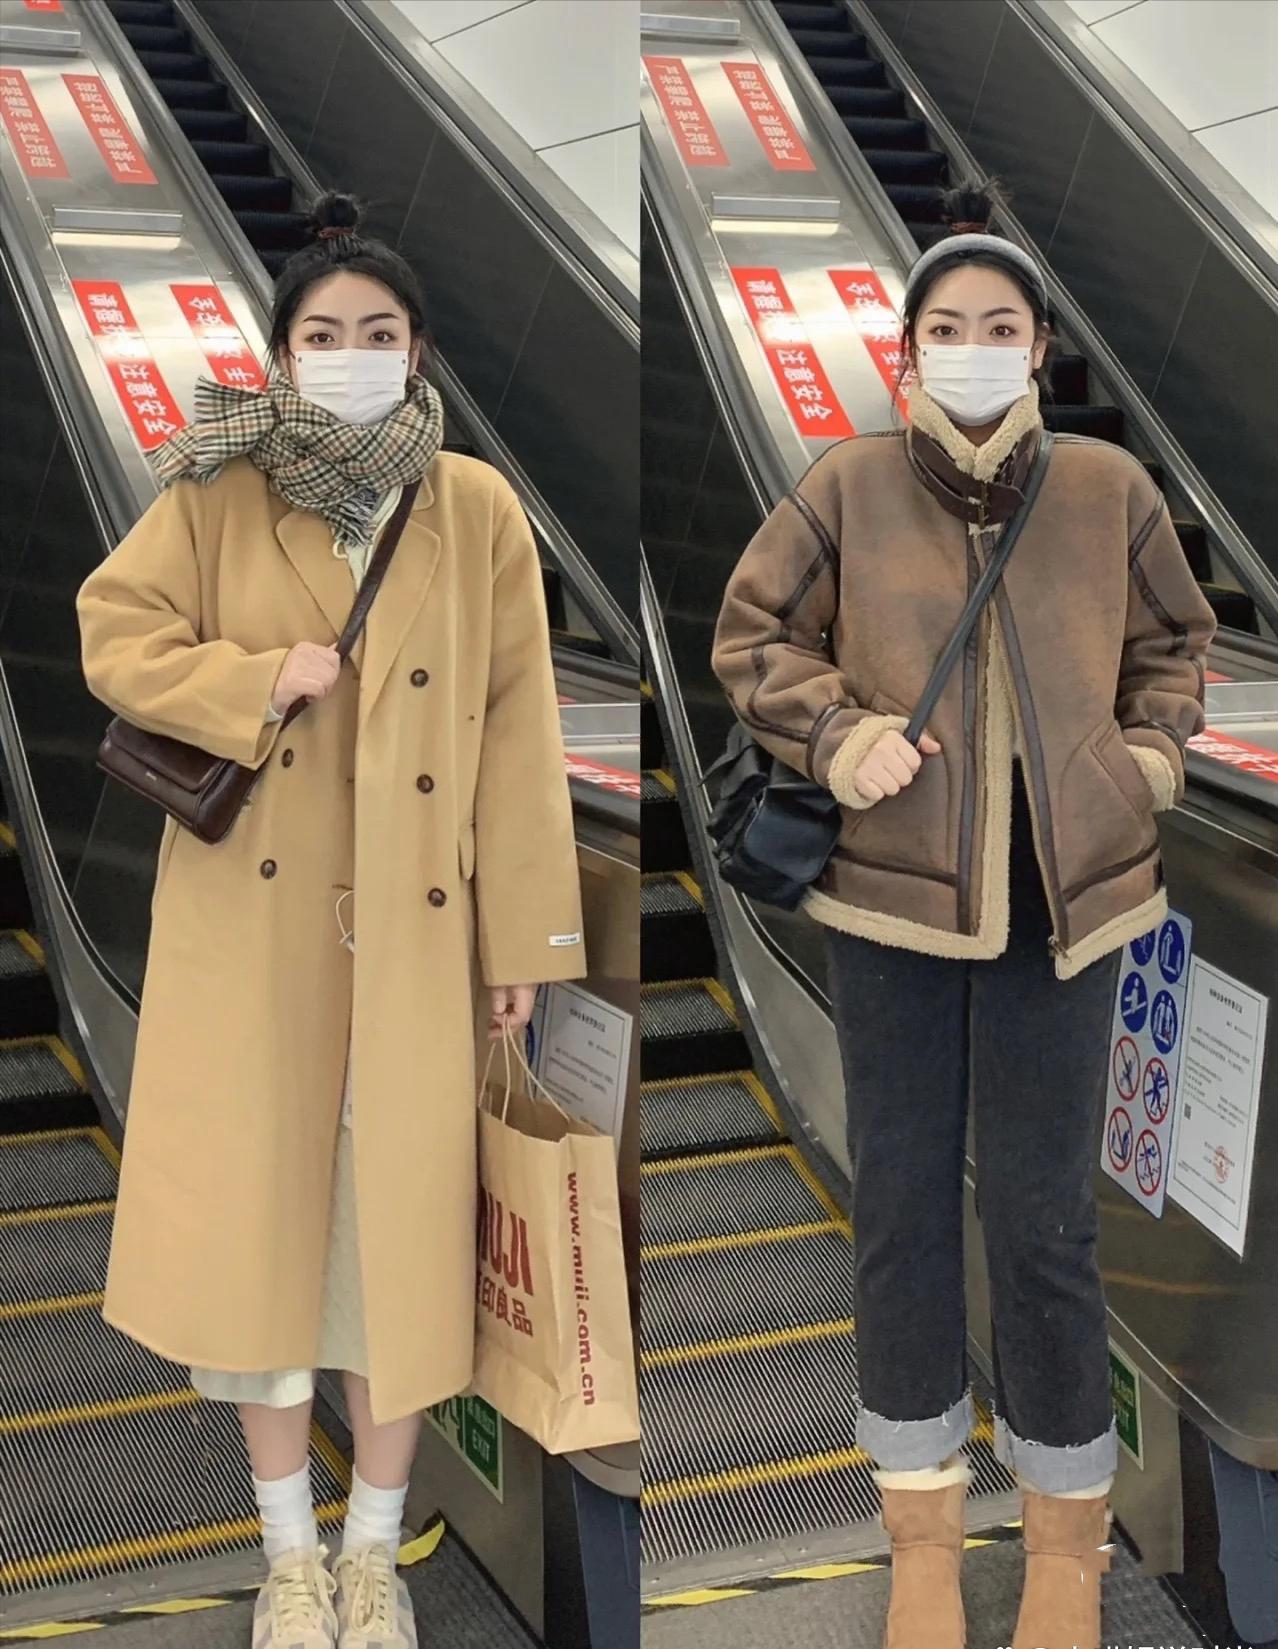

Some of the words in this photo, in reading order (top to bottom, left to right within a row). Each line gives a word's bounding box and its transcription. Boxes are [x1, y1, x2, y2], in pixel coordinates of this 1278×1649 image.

[118, 363, 176, 435] 注意安全
[776, 349, 832, 420] 注意安全
[477, 1270, 534, 1338] 印良品
